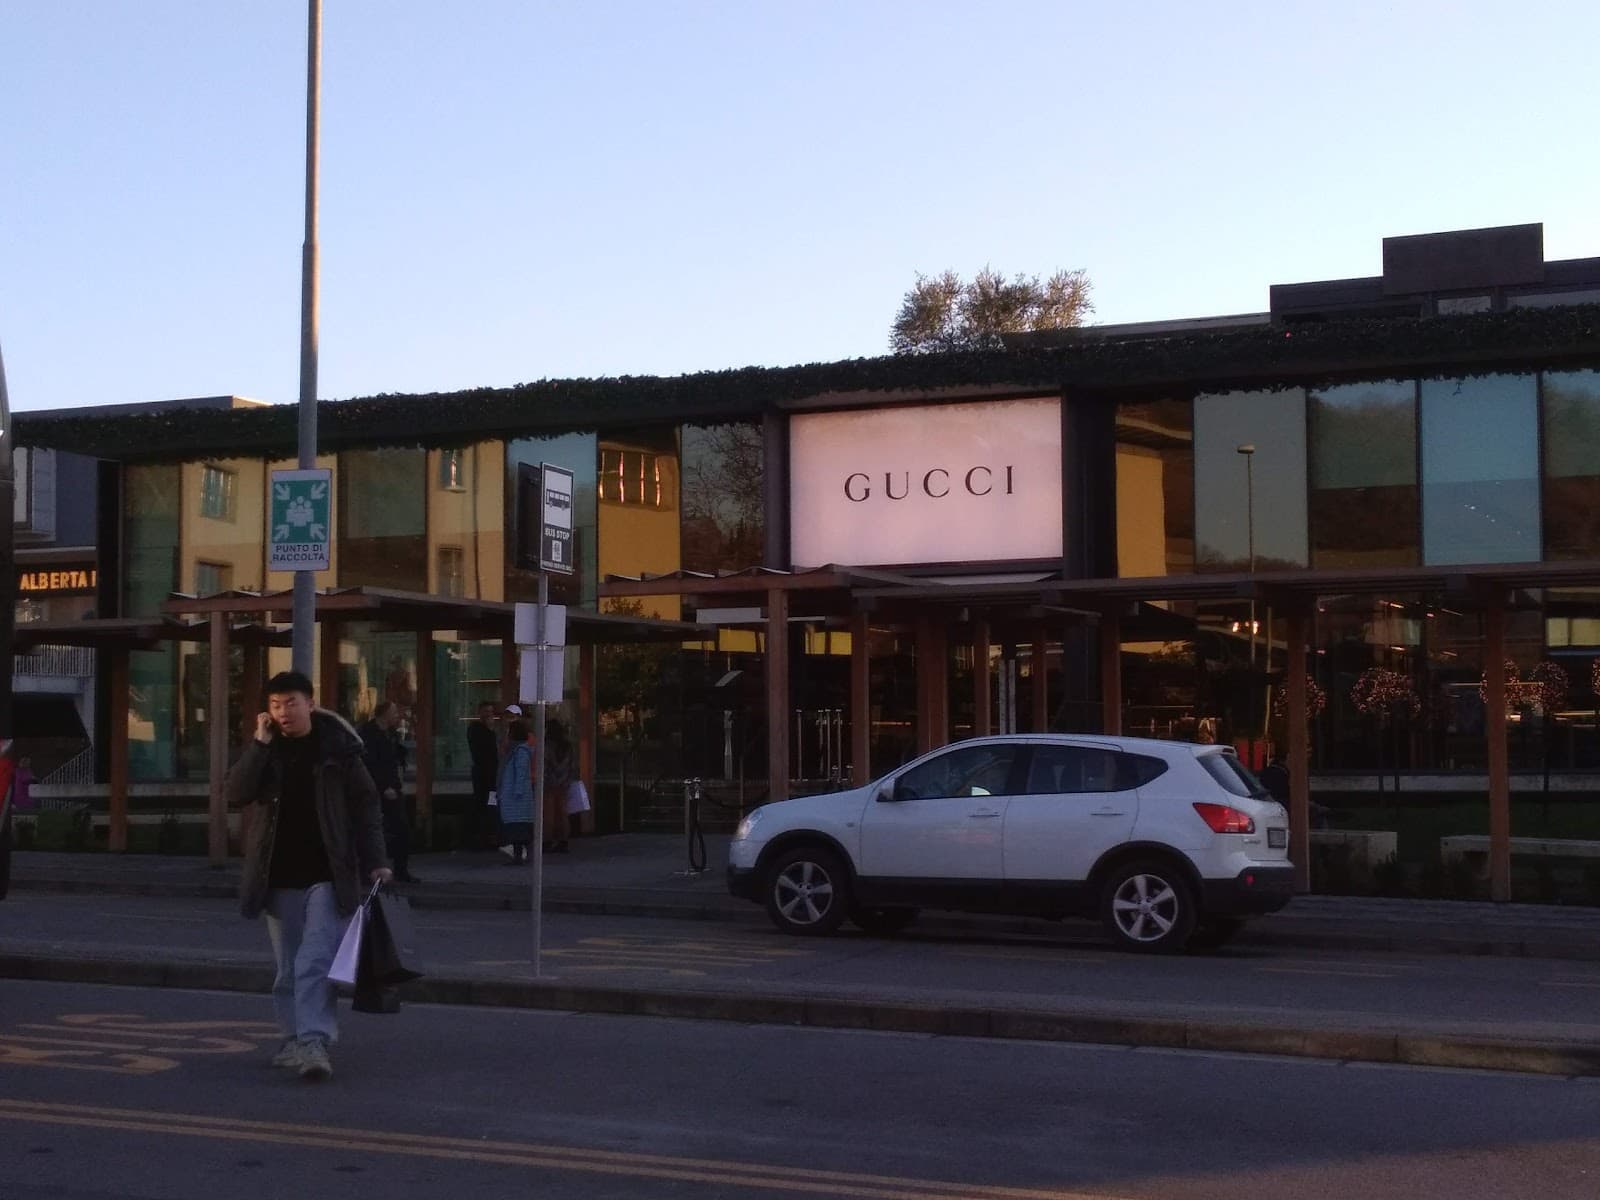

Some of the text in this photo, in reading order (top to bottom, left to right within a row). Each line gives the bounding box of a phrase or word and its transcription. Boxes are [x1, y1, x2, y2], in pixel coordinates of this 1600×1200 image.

[844, 465, 1013, 502] GUCCI
[544, 527, 570, 541] BUS STOP
[275, 544, 323, 553] PUNTO DI
[272, 553, 325, 562] RACCOLTA
[20, 570, 88, 590] ALBERTA
